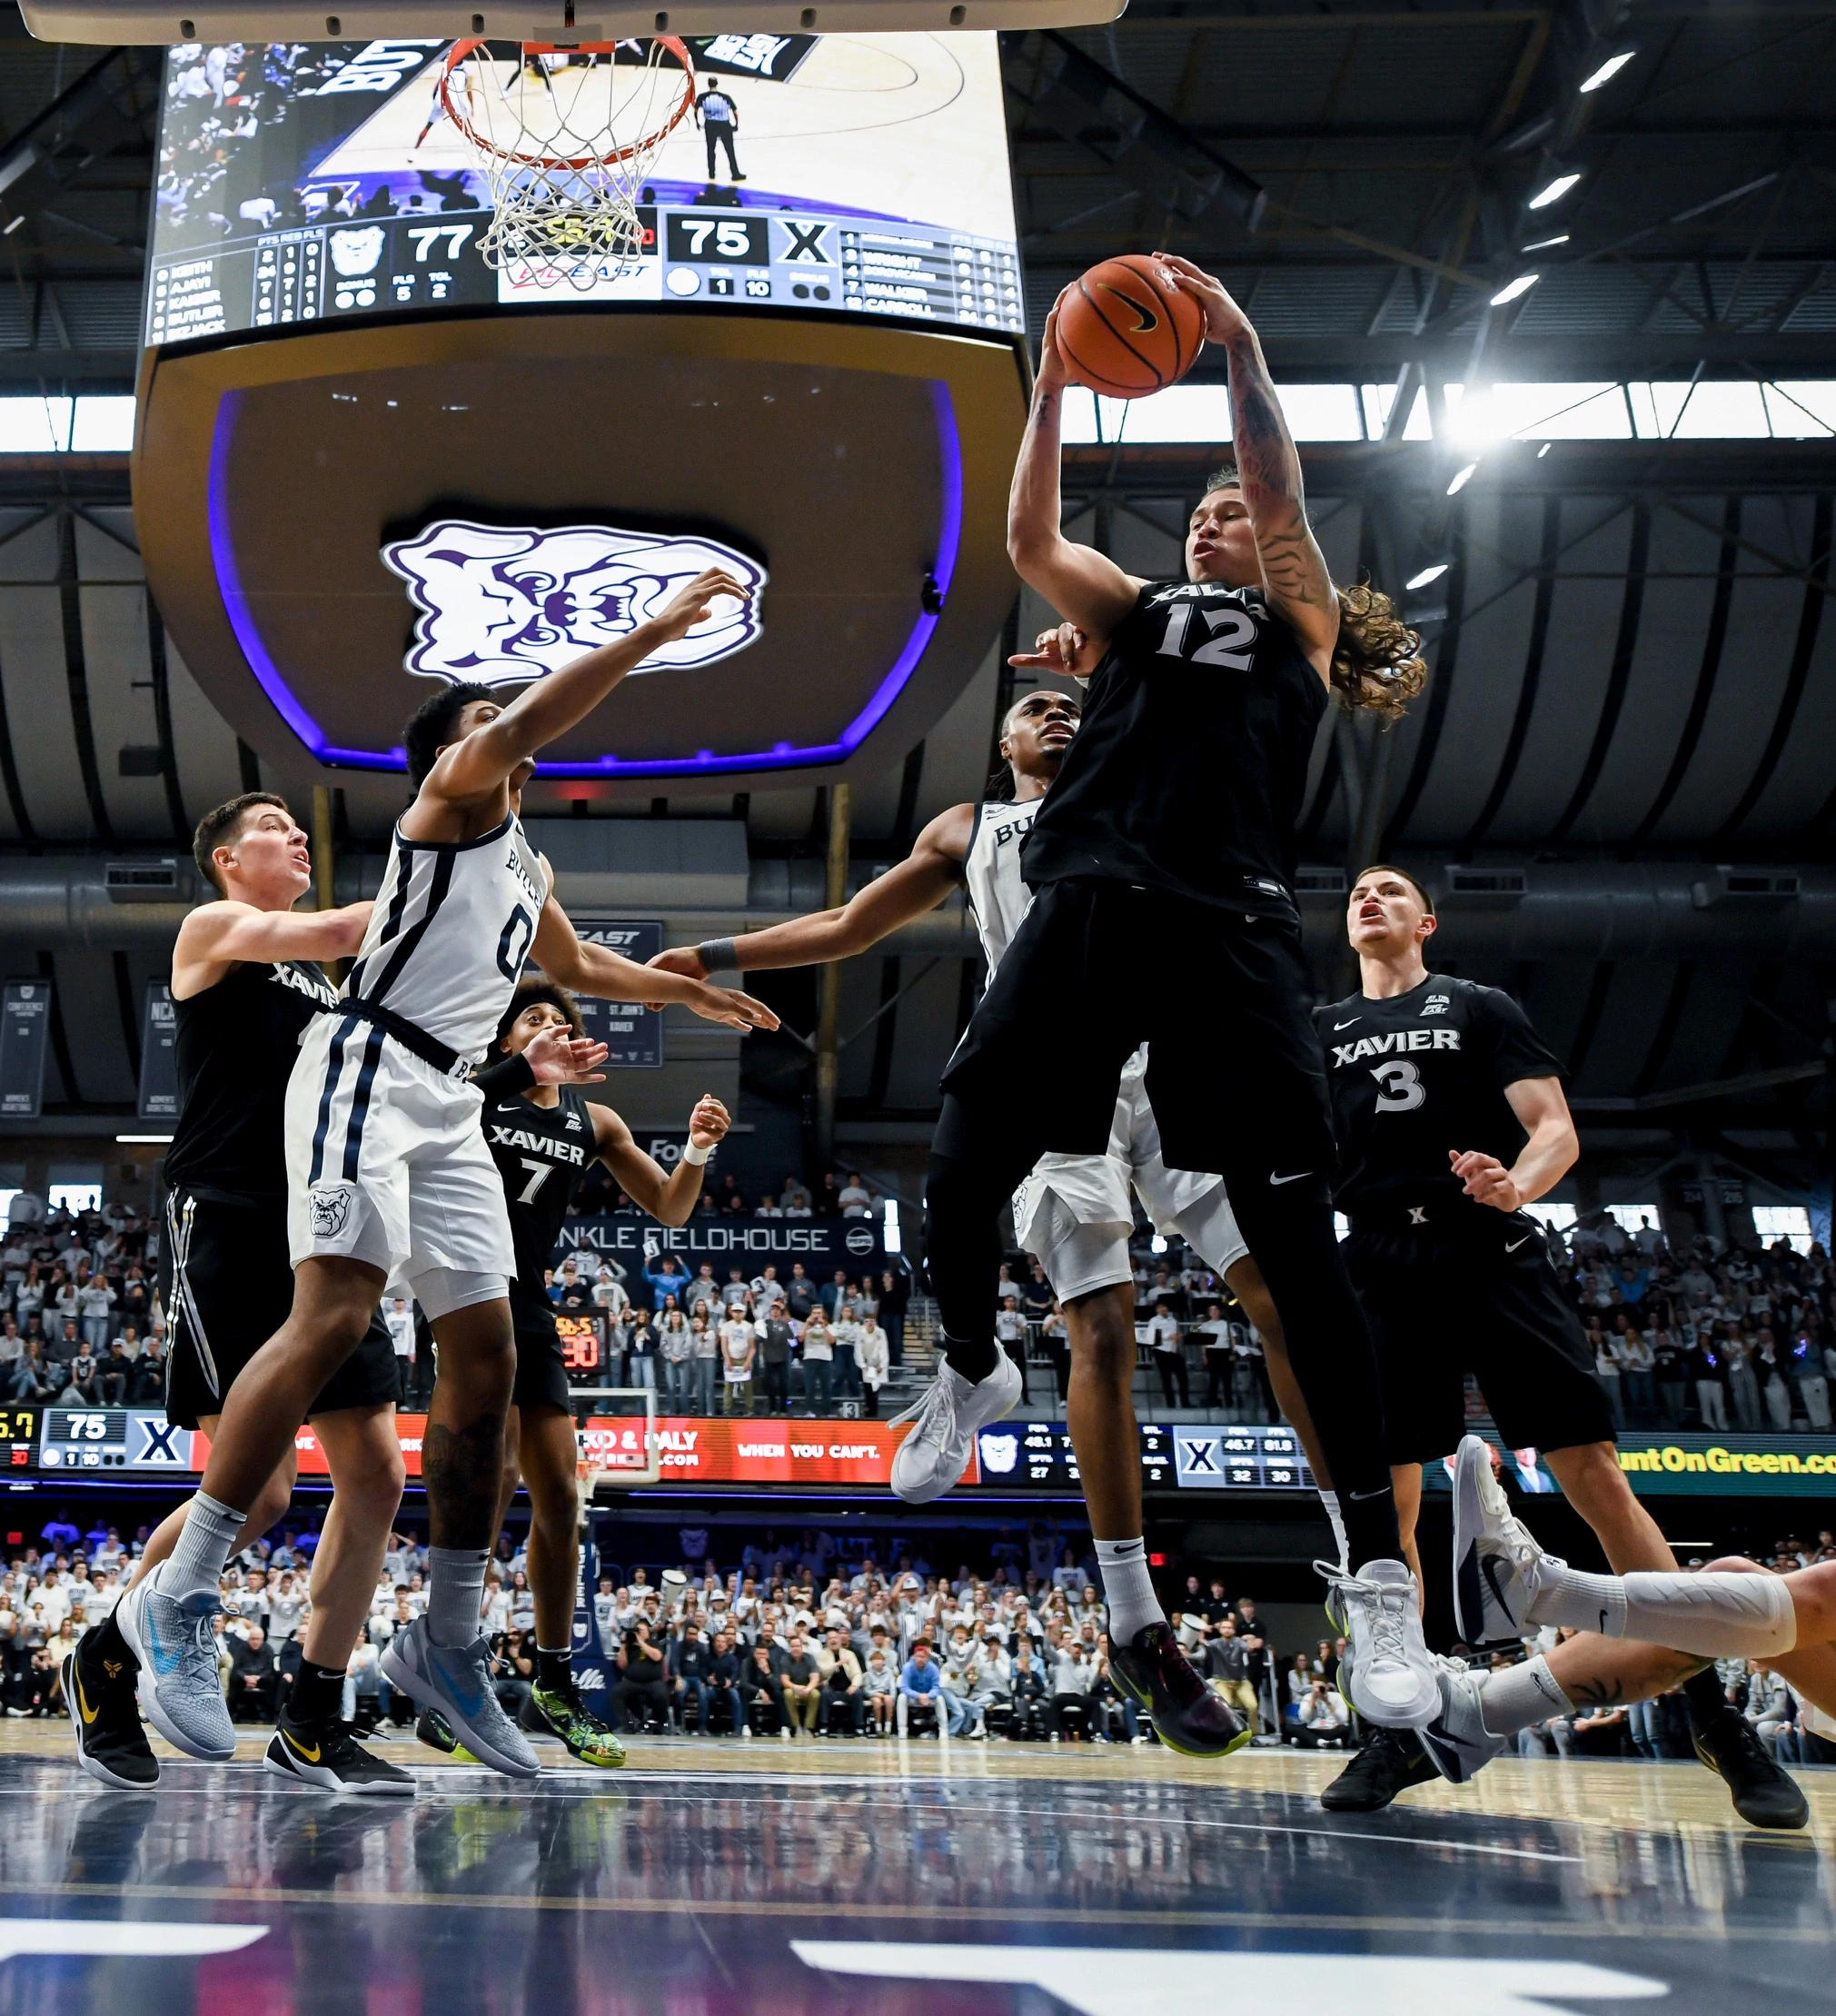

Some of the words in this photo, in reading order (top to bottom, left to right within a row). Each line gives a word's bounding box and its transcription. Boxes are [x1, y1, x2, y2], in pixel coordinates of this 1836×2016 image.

[303, 228, 323, 240] FLS
[408, 224, 473, 262] 77
[681, 220, 750, 256] 75
[773, 217, 838, 268] X
[262, 250, 273, 263] 2
[286, 246, 294, 259] 1
[306, 243, 319, 255] 0
[846, 233, 855, 245] 1
[1003, 254, 1011, 267] 1
[307, 259, 315, 272] 1
[847, 264, 858, 278] 4
[392, 274, 415, 285] FLS
[716, 280, 727, 294] 1
[746, 281, 769, 296] 10
[847, 281, 859, 293] 7
[155, 301, 165, 313] 7
[260, 281, 272, 294] 7
[283, 277, 295, 291] 7
[304, 274, 316, 287] 2
[397, 286, 411, 301] 5
[432, 283, 446, 298] 2
[167, 304, 224, 326] BUTLER
[283, 293, 292, 306] 1
[306, 290, 314, 303] 1
[282, 309, 293, 322] 2
[303, 306, 315, 319] 0
[865, 298, 937, 318] CARROLL
[1009, 318, 1017, 331] 1
[1156, 603, 1259, 672] 12
[505, 849, 541, 910] BUTLE
[496, 902, 533, 984] 0
[151, 1002, 175, 1020] NCA
[1330, 1029, 1462, 1068] XAVIER
[1369, 1059, 1426, 1114] 3
[488, 1125, 585, 1167] XAVIER
[517, 1157, 556, 1205] 7
[644, 1227, 830, 1251] FIELDHOUSE
[562, 1336, 598, 1367] 30
[66, 1414, 107, 1439] 75
[620, 1430, 639, 1450] &
[1147, 1438, 1158, 1449] 2
[66, 1453, 75, 1465] 1
[83, 1452, 100, 1465] 10
[738, 1444, 786, 1457] WHEN
[789, 1445, 824, 1458] YOU
[829, 1445, 880, 1459] CAN'T.
[1030, 1466, 1049, 1479] 27
[1150, 1469, 1161, 1480] 2
[1232, 1470, 1252, 1482] 32
[1272, 1471, 1291, 1483] 30
